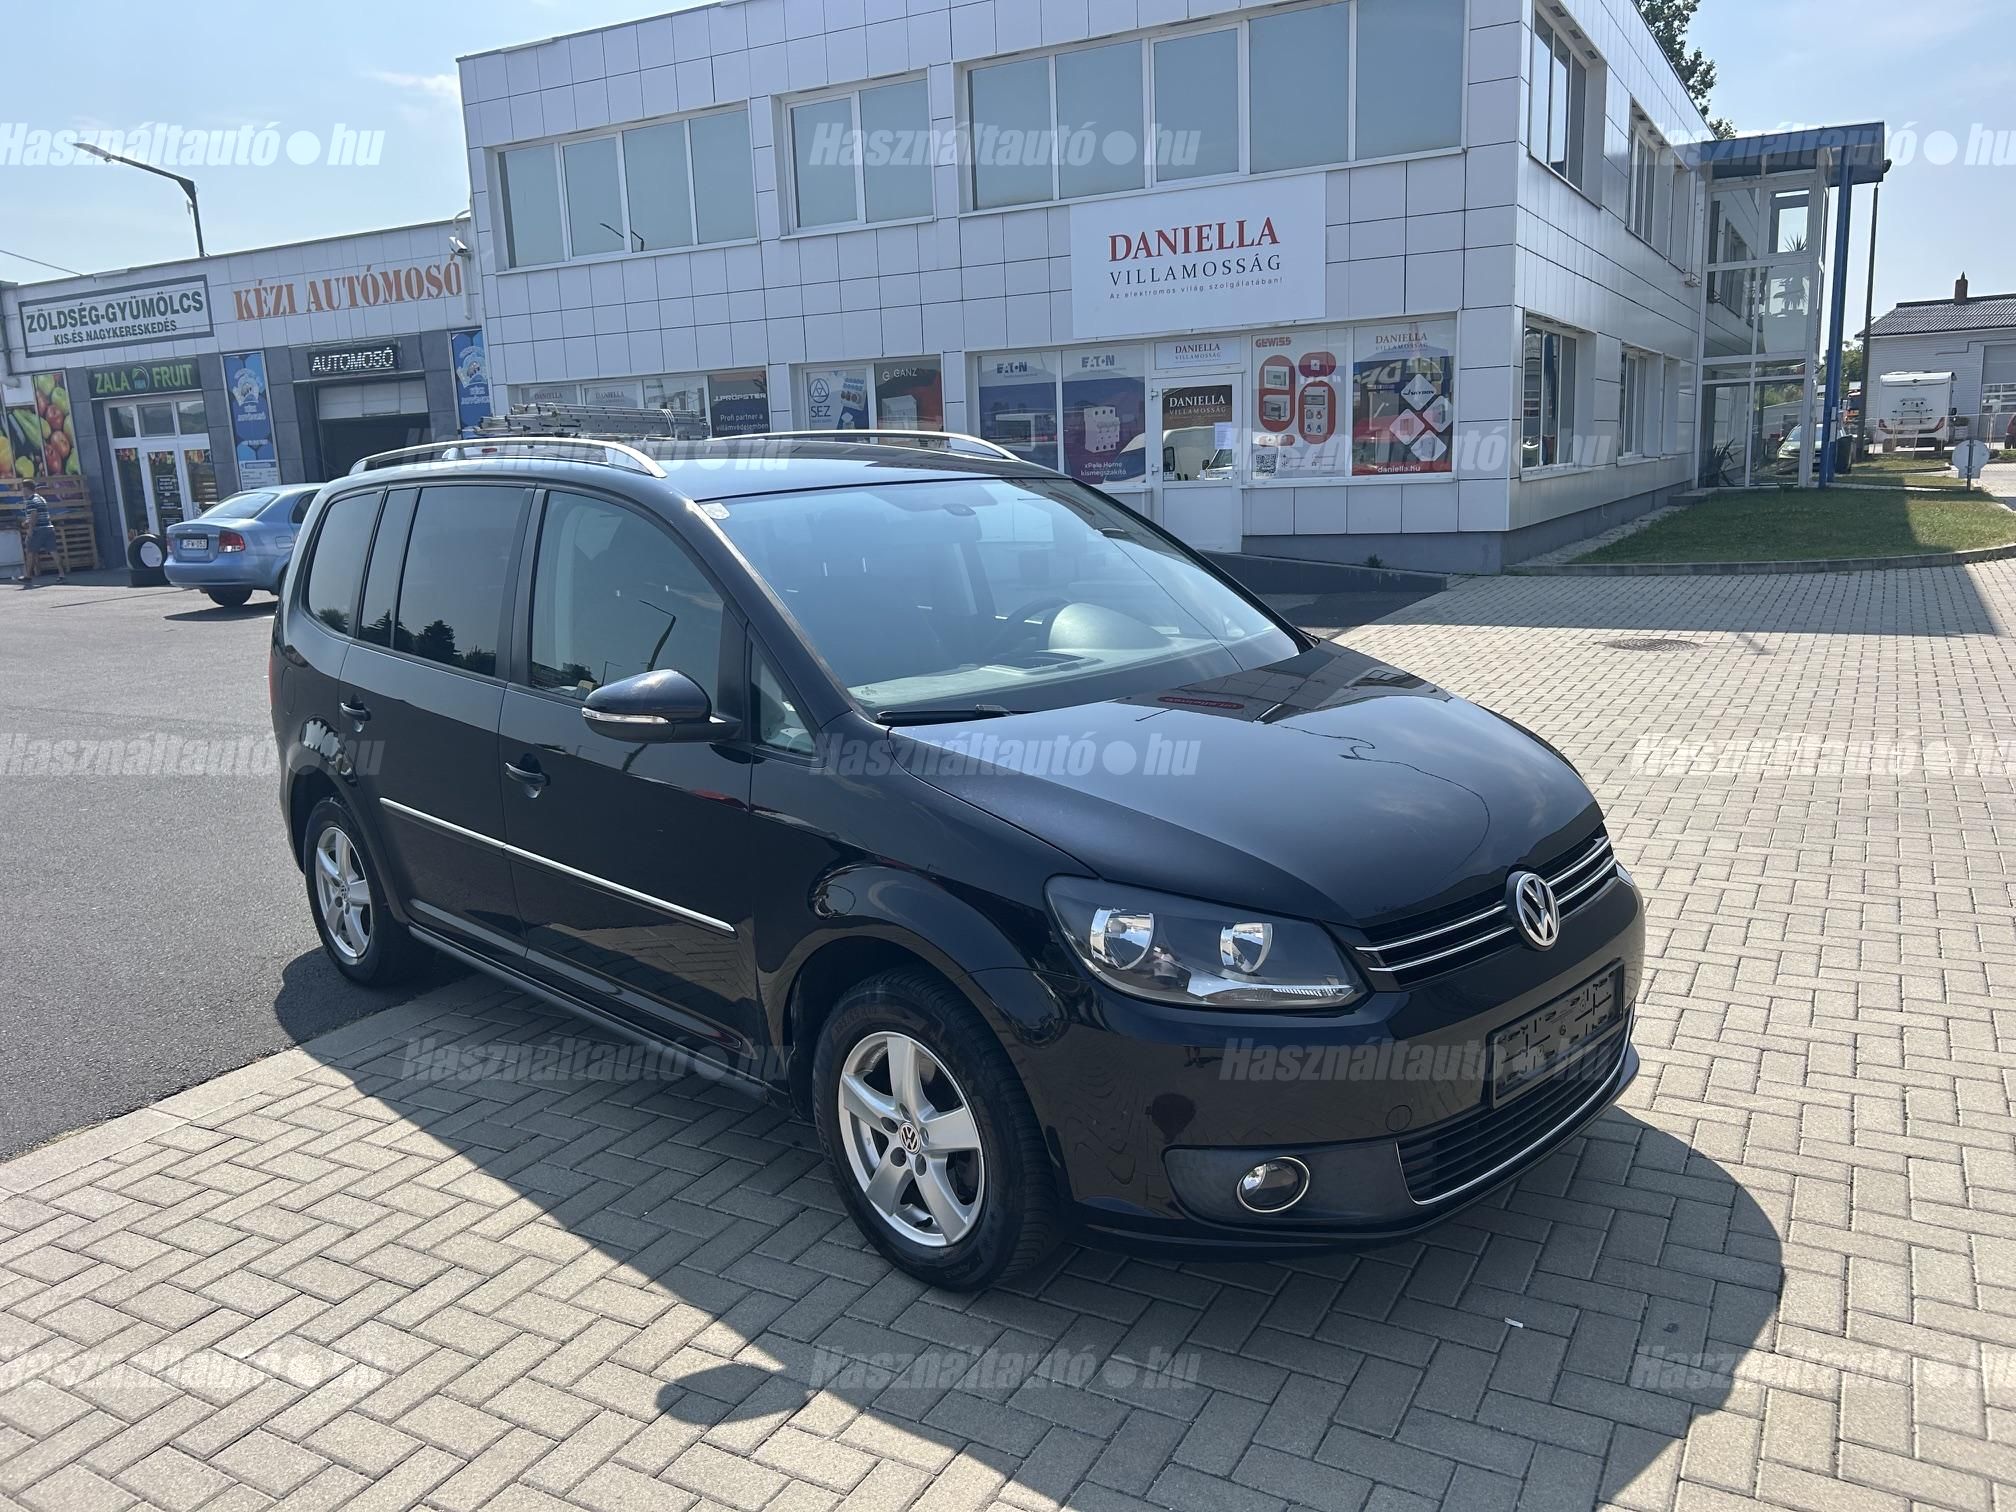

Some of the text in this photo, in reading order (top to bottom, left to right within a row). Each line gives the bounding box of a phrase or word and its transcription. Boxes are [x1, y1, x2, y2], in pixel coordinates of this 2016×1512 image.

[1108, 216, 1281, 262] DANIELLA
[1109, 253, 1281, 287] VILLAMOSSÁG
[233, 255, 463, 321] KÉZI AUTÓMOSÓ
[26, 291, 204, 333] ZÖLDSÉG-GYÜMÖLCS
[86, 318, 177, 341] NAGYKERESKEDÉS
[1376, 333, 1428, 344] DANIELLA
[1175, 343, 1221, 354] DANIELLA
[95, 364, 193, 394] ZALA FRUIT
[810, 405, 831, 418] SEZ
[1169, 394, 1226, 407] DANIELLA
